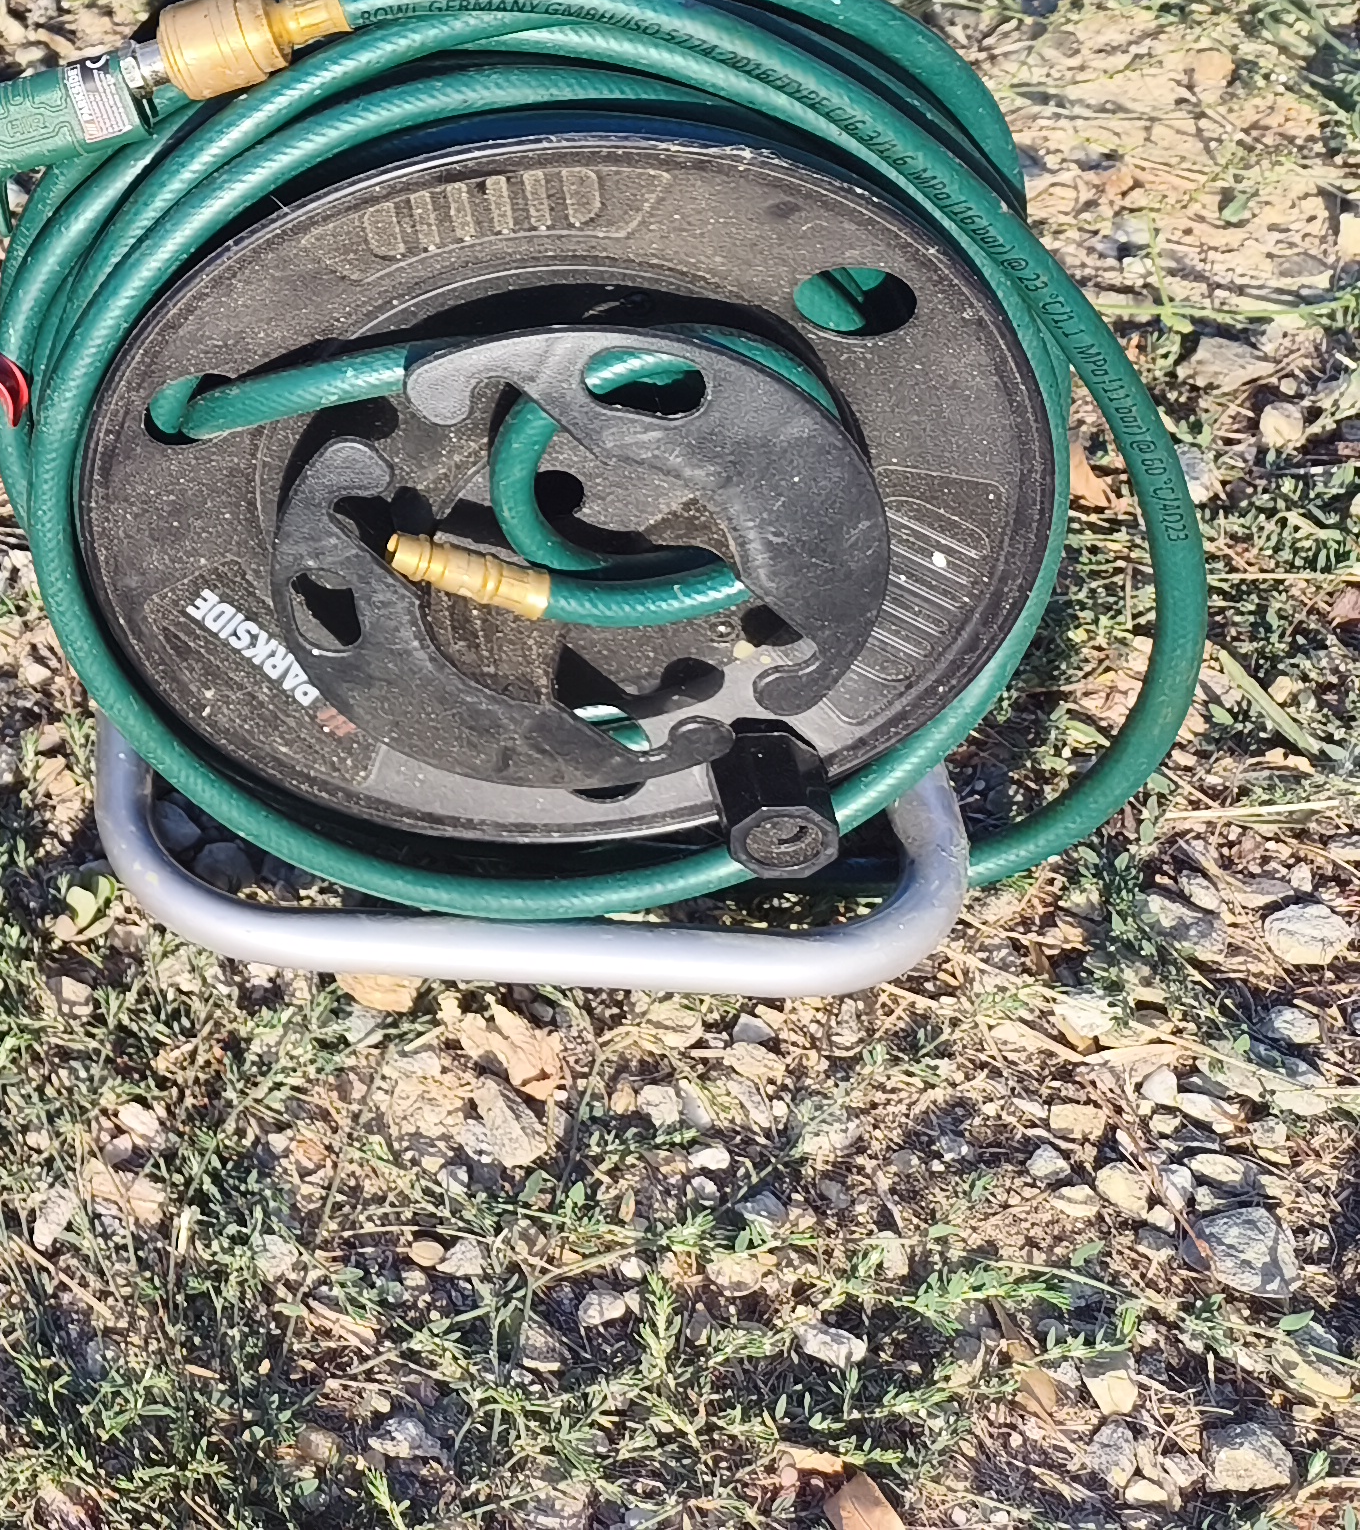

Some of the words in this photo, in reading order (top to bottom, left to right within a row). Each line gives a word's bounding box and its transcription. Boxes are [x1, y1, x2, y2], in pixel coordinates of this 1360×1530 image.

[67, 65, 94, 122] PARKSIDE
[1016, 272, 1048, 292] 23
[1141, 457, 1167, 476] 60
[186, 589, 320, 707] PARKSIDE
